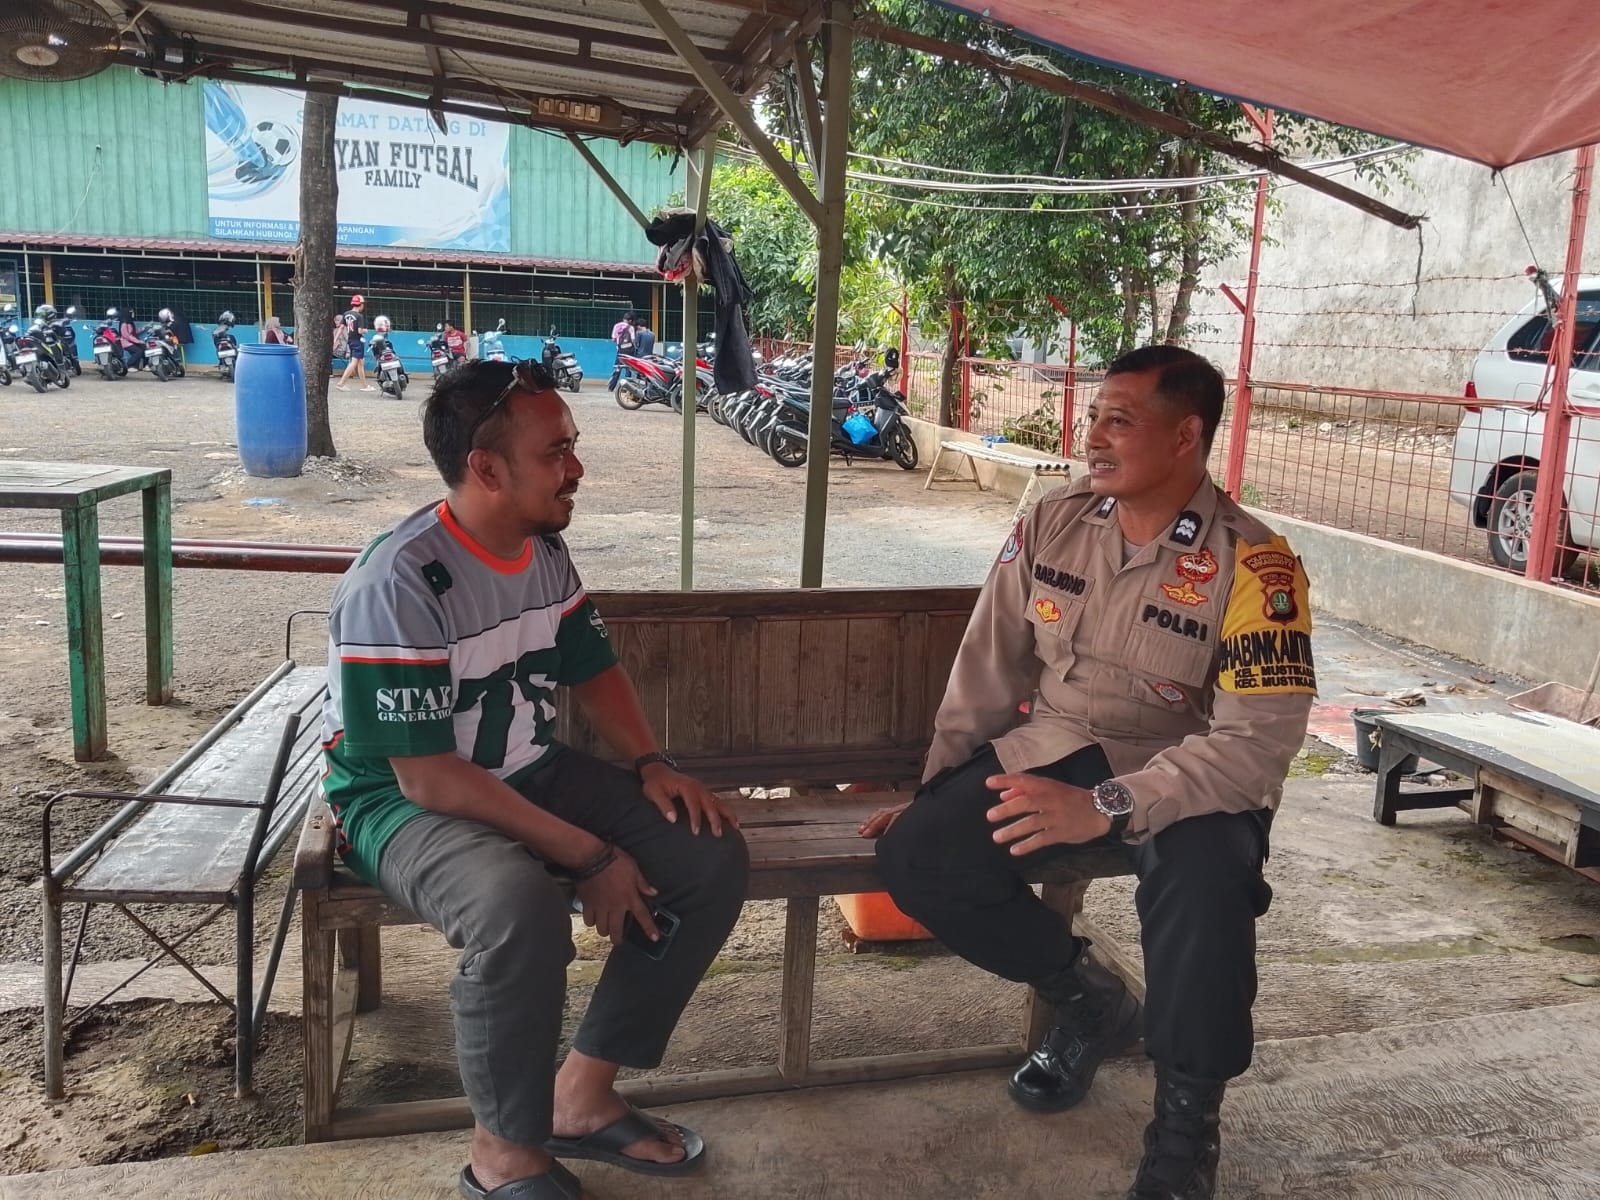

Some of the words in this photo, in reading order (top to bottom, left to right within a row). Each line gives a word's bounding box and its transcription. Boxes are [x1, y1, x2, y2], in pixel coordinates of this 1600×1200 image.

[334, 138, 380, 171] YAN
[390, 142, 478, 192] FUTSAL
[364, 169, 422, 189] FAMILY
[214, 219, 242, 227] UNTUK
[243, 221, 287, 230] INFORMASI
[338, 226, 375, 235] APANGAN
[215, 228, 255, 237] SILAHKAN
[256, 230, 292, 238] HUBUNGI
[1034, 563, 1086, 596] SARJONO
[1143, 604, 1208, 641] POLRI
[377, 685, 451, 712] STAY
[378, 708, 452, 722] GENERATIO
